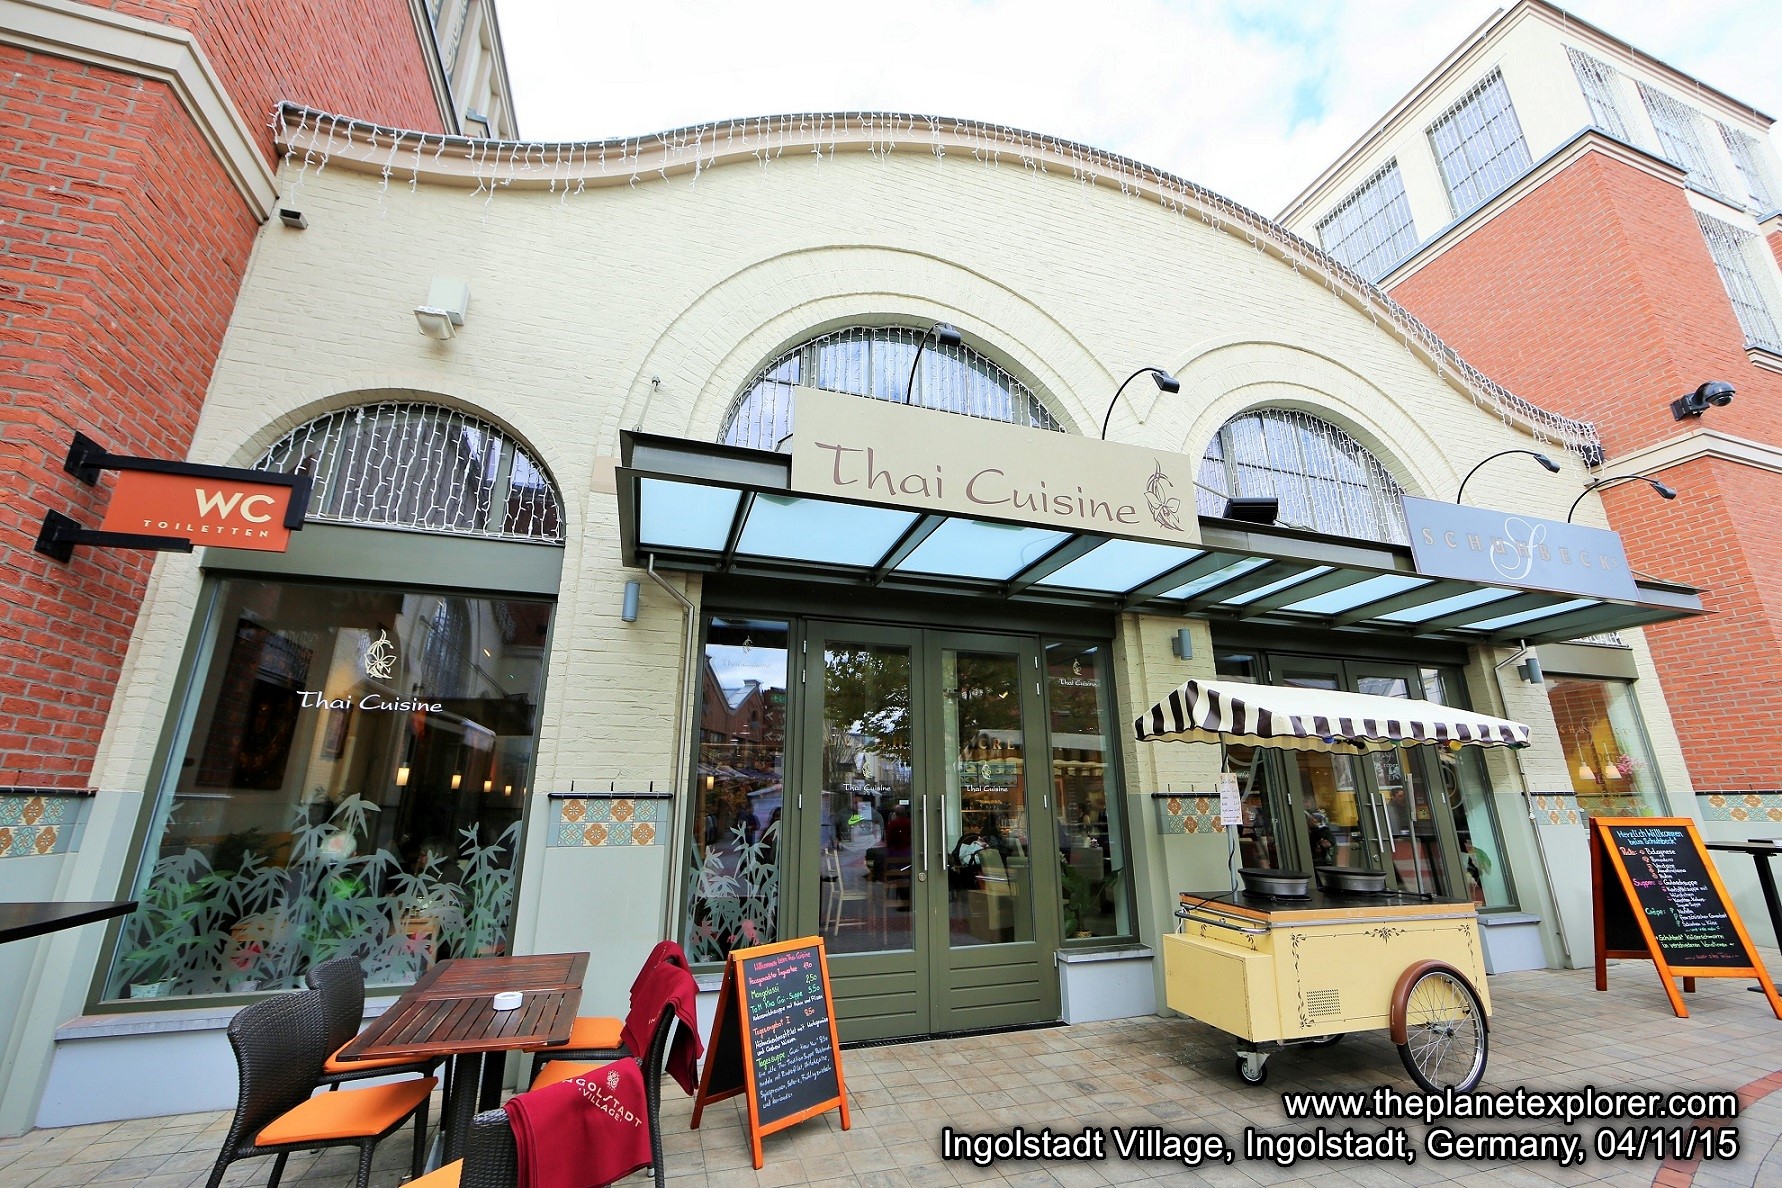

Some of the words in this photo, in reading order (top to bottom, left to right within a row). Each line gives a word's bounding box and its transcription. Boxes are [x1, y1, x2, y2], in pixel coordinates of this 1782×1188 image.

[814, 441, 943, 499] Thai
[965, 468, 1140, 524] Cuisine
[195, 488, 275, 523] WC
[143, 519, 269, 538] TOILETTEN
[1059, 678, 1074, 686] Thai
[296, 691, 352, 710] Thai
[359, 694, 443, 713] Cuisine
[843, 783, 861, 792] Thai
